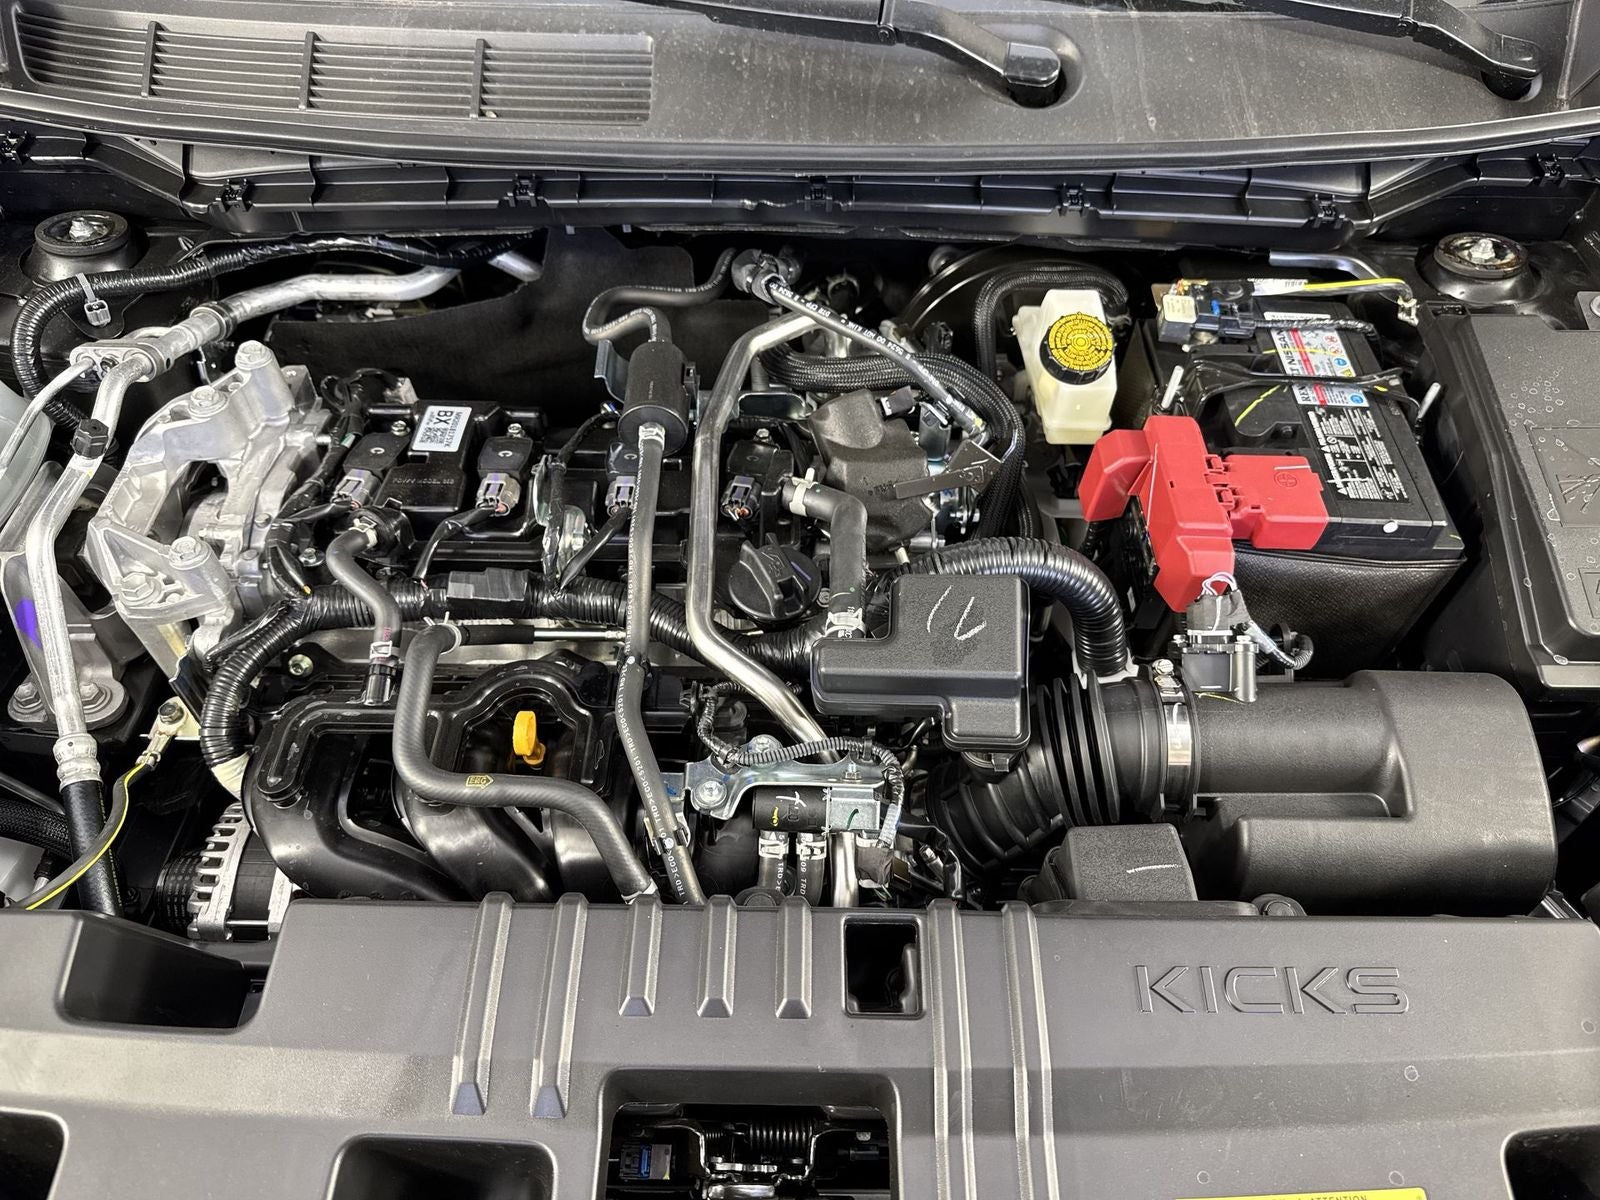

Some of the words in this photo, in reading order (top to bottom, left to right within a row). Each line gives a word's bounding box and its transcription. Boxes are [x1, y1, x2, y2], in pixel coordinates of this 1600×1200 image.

[863, 329, 876, 340] NOT
[875, 335, 887, 345] DO
[433, 410, 454, 425] BX
[1134, 964, 1409, 1015] KICKS
